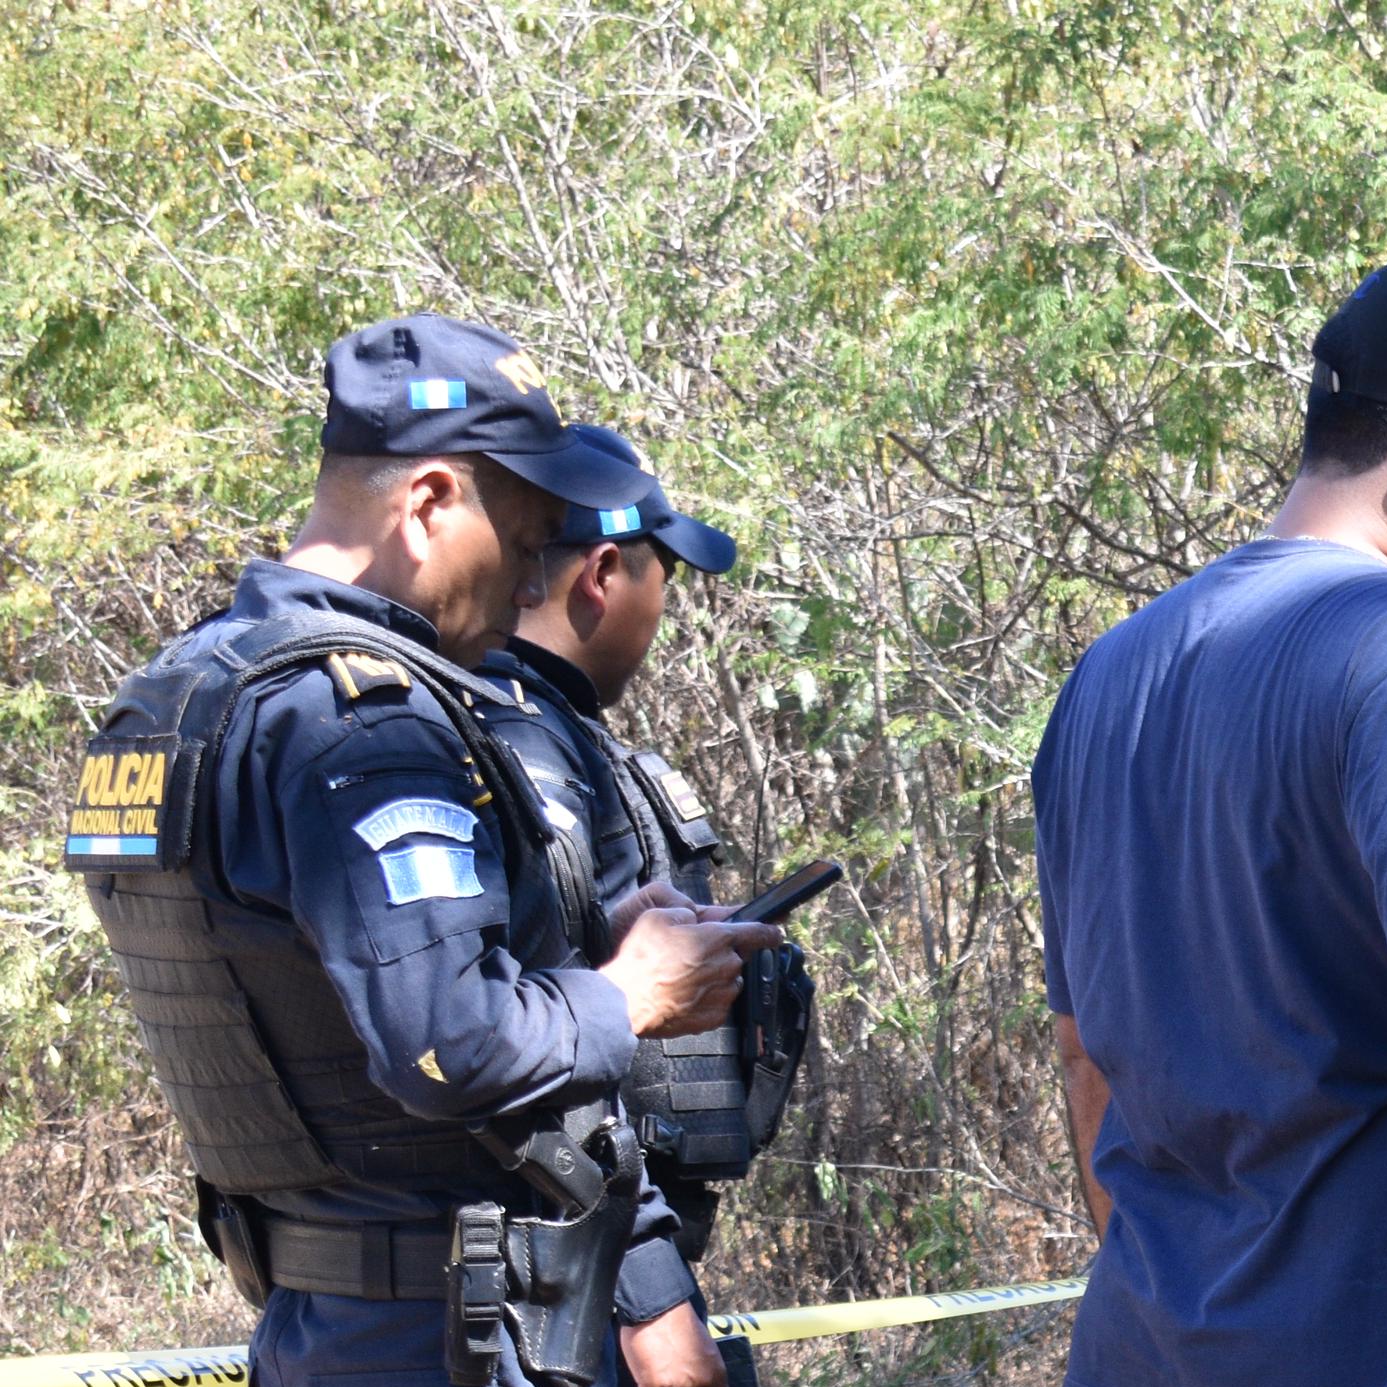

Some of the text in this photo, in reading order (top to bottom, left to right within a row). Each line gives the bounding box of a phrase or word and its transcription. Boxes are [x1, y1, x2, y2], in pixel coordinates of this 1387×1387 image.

[75, 752, 166, 806] POLICIA
[69, 809, 158, 835] NACIONAL CIVIL
